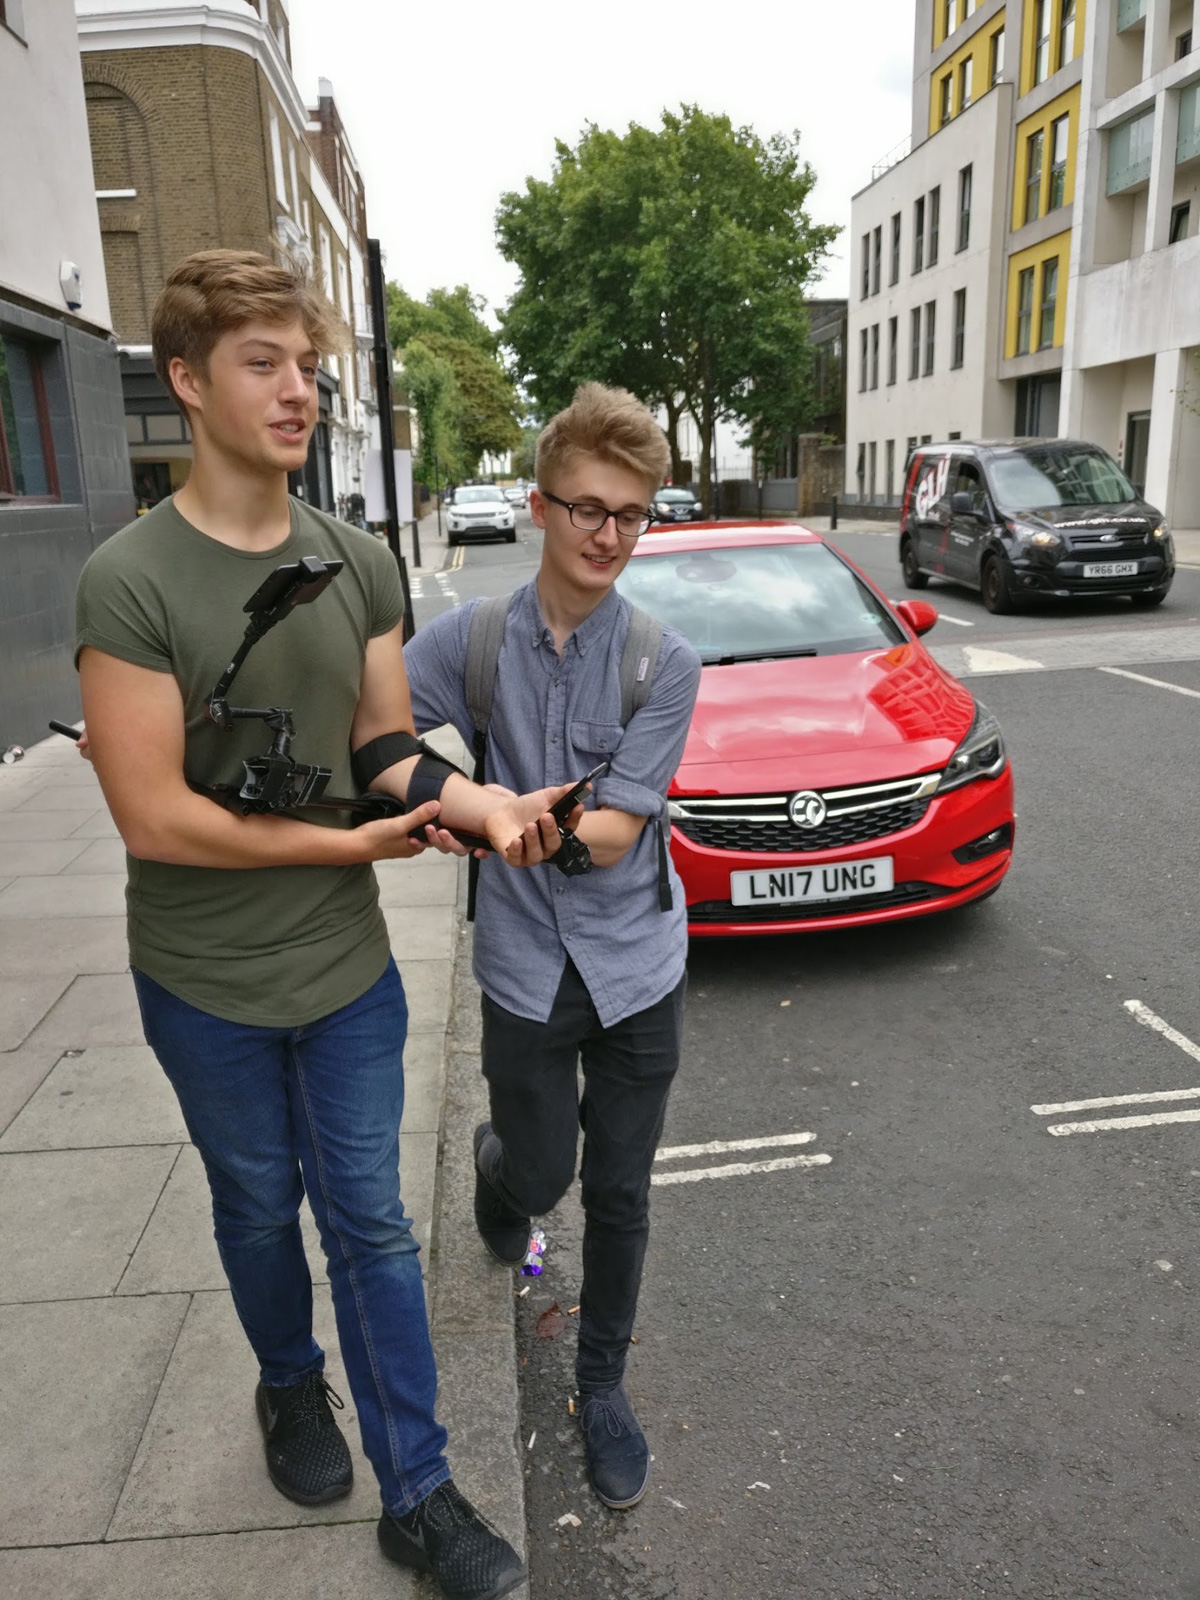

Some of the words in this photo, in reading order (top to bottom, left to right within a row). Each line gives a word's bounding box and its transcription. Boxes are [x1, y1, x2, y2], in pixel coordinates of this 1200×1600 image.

[915, 451, 953, 520] GLH
[1089, 565, 1113, 575] YR66
[749, 871, 812, 899] LN17
[822, 864, 876, 893] UNG
